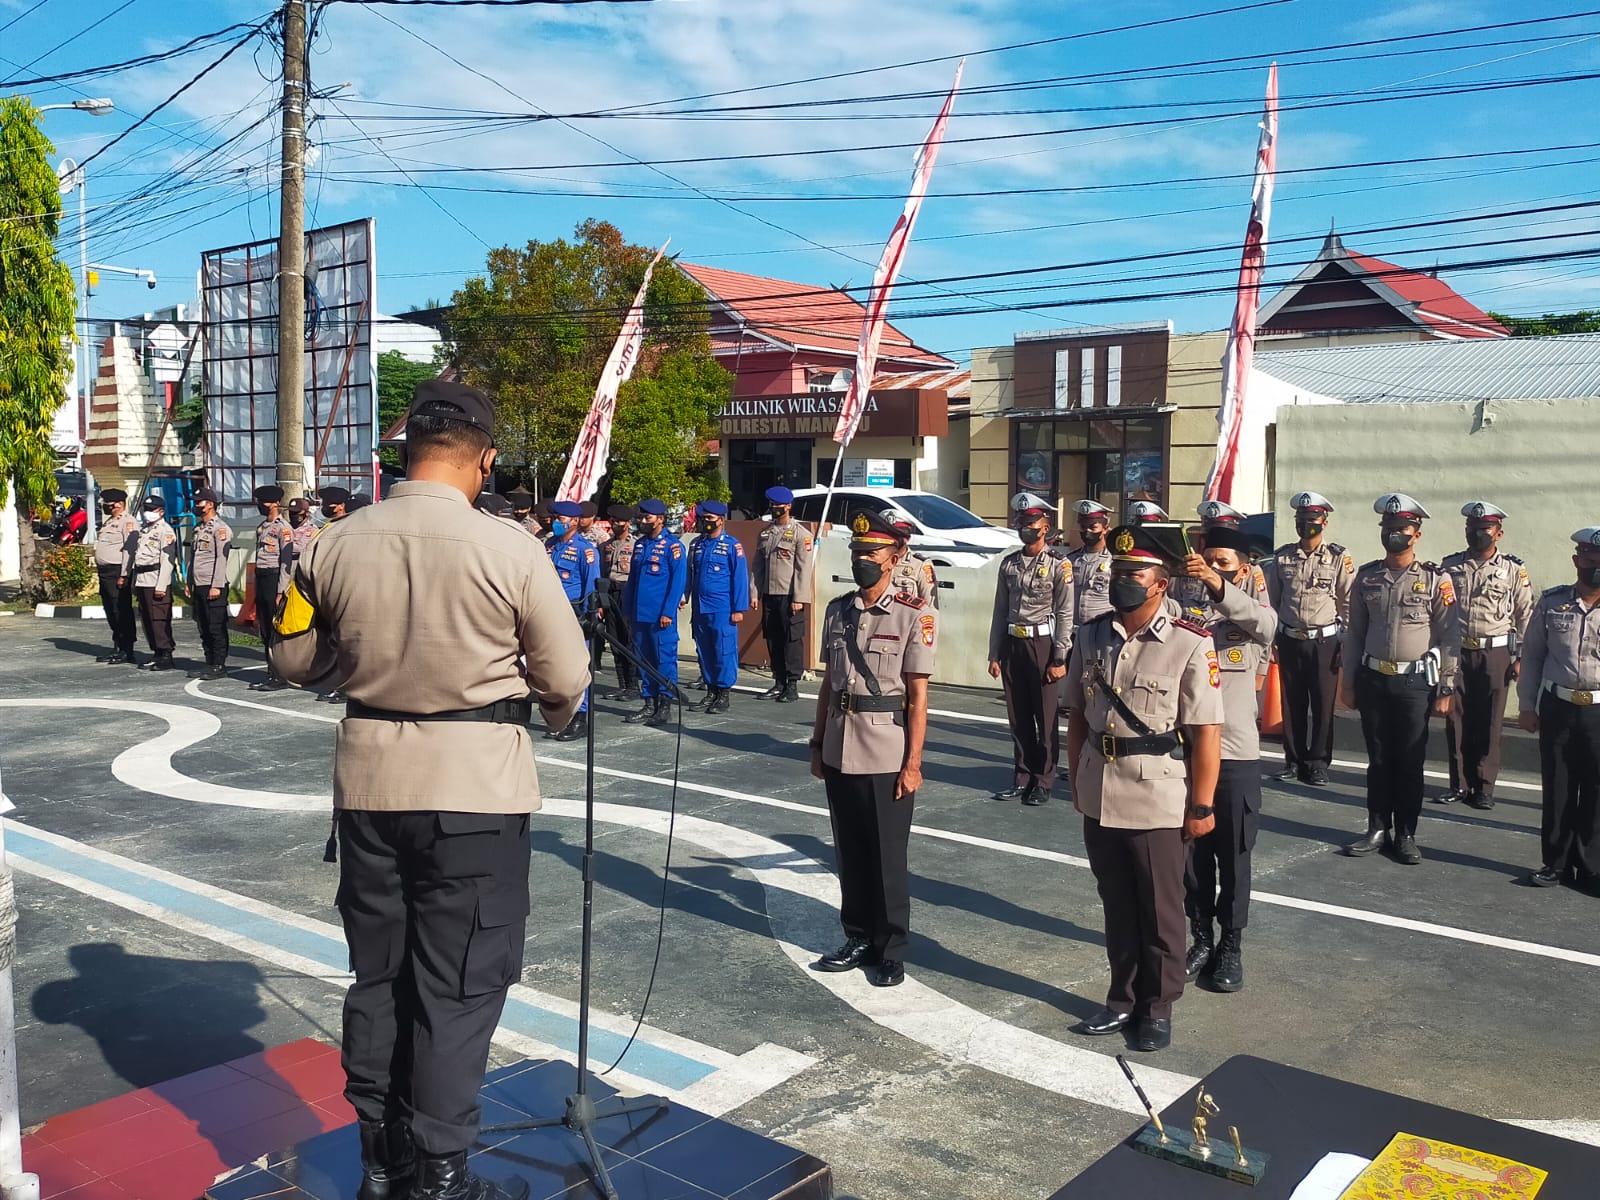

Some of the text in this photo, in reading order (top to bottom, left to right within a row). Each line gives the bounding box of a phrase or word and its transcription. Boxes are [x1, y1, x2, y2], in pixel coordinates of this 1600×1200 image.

[706, 399, 785, 416] OLIKLINIK
[719, 416, 870, 434] OLRESTA MAMU
